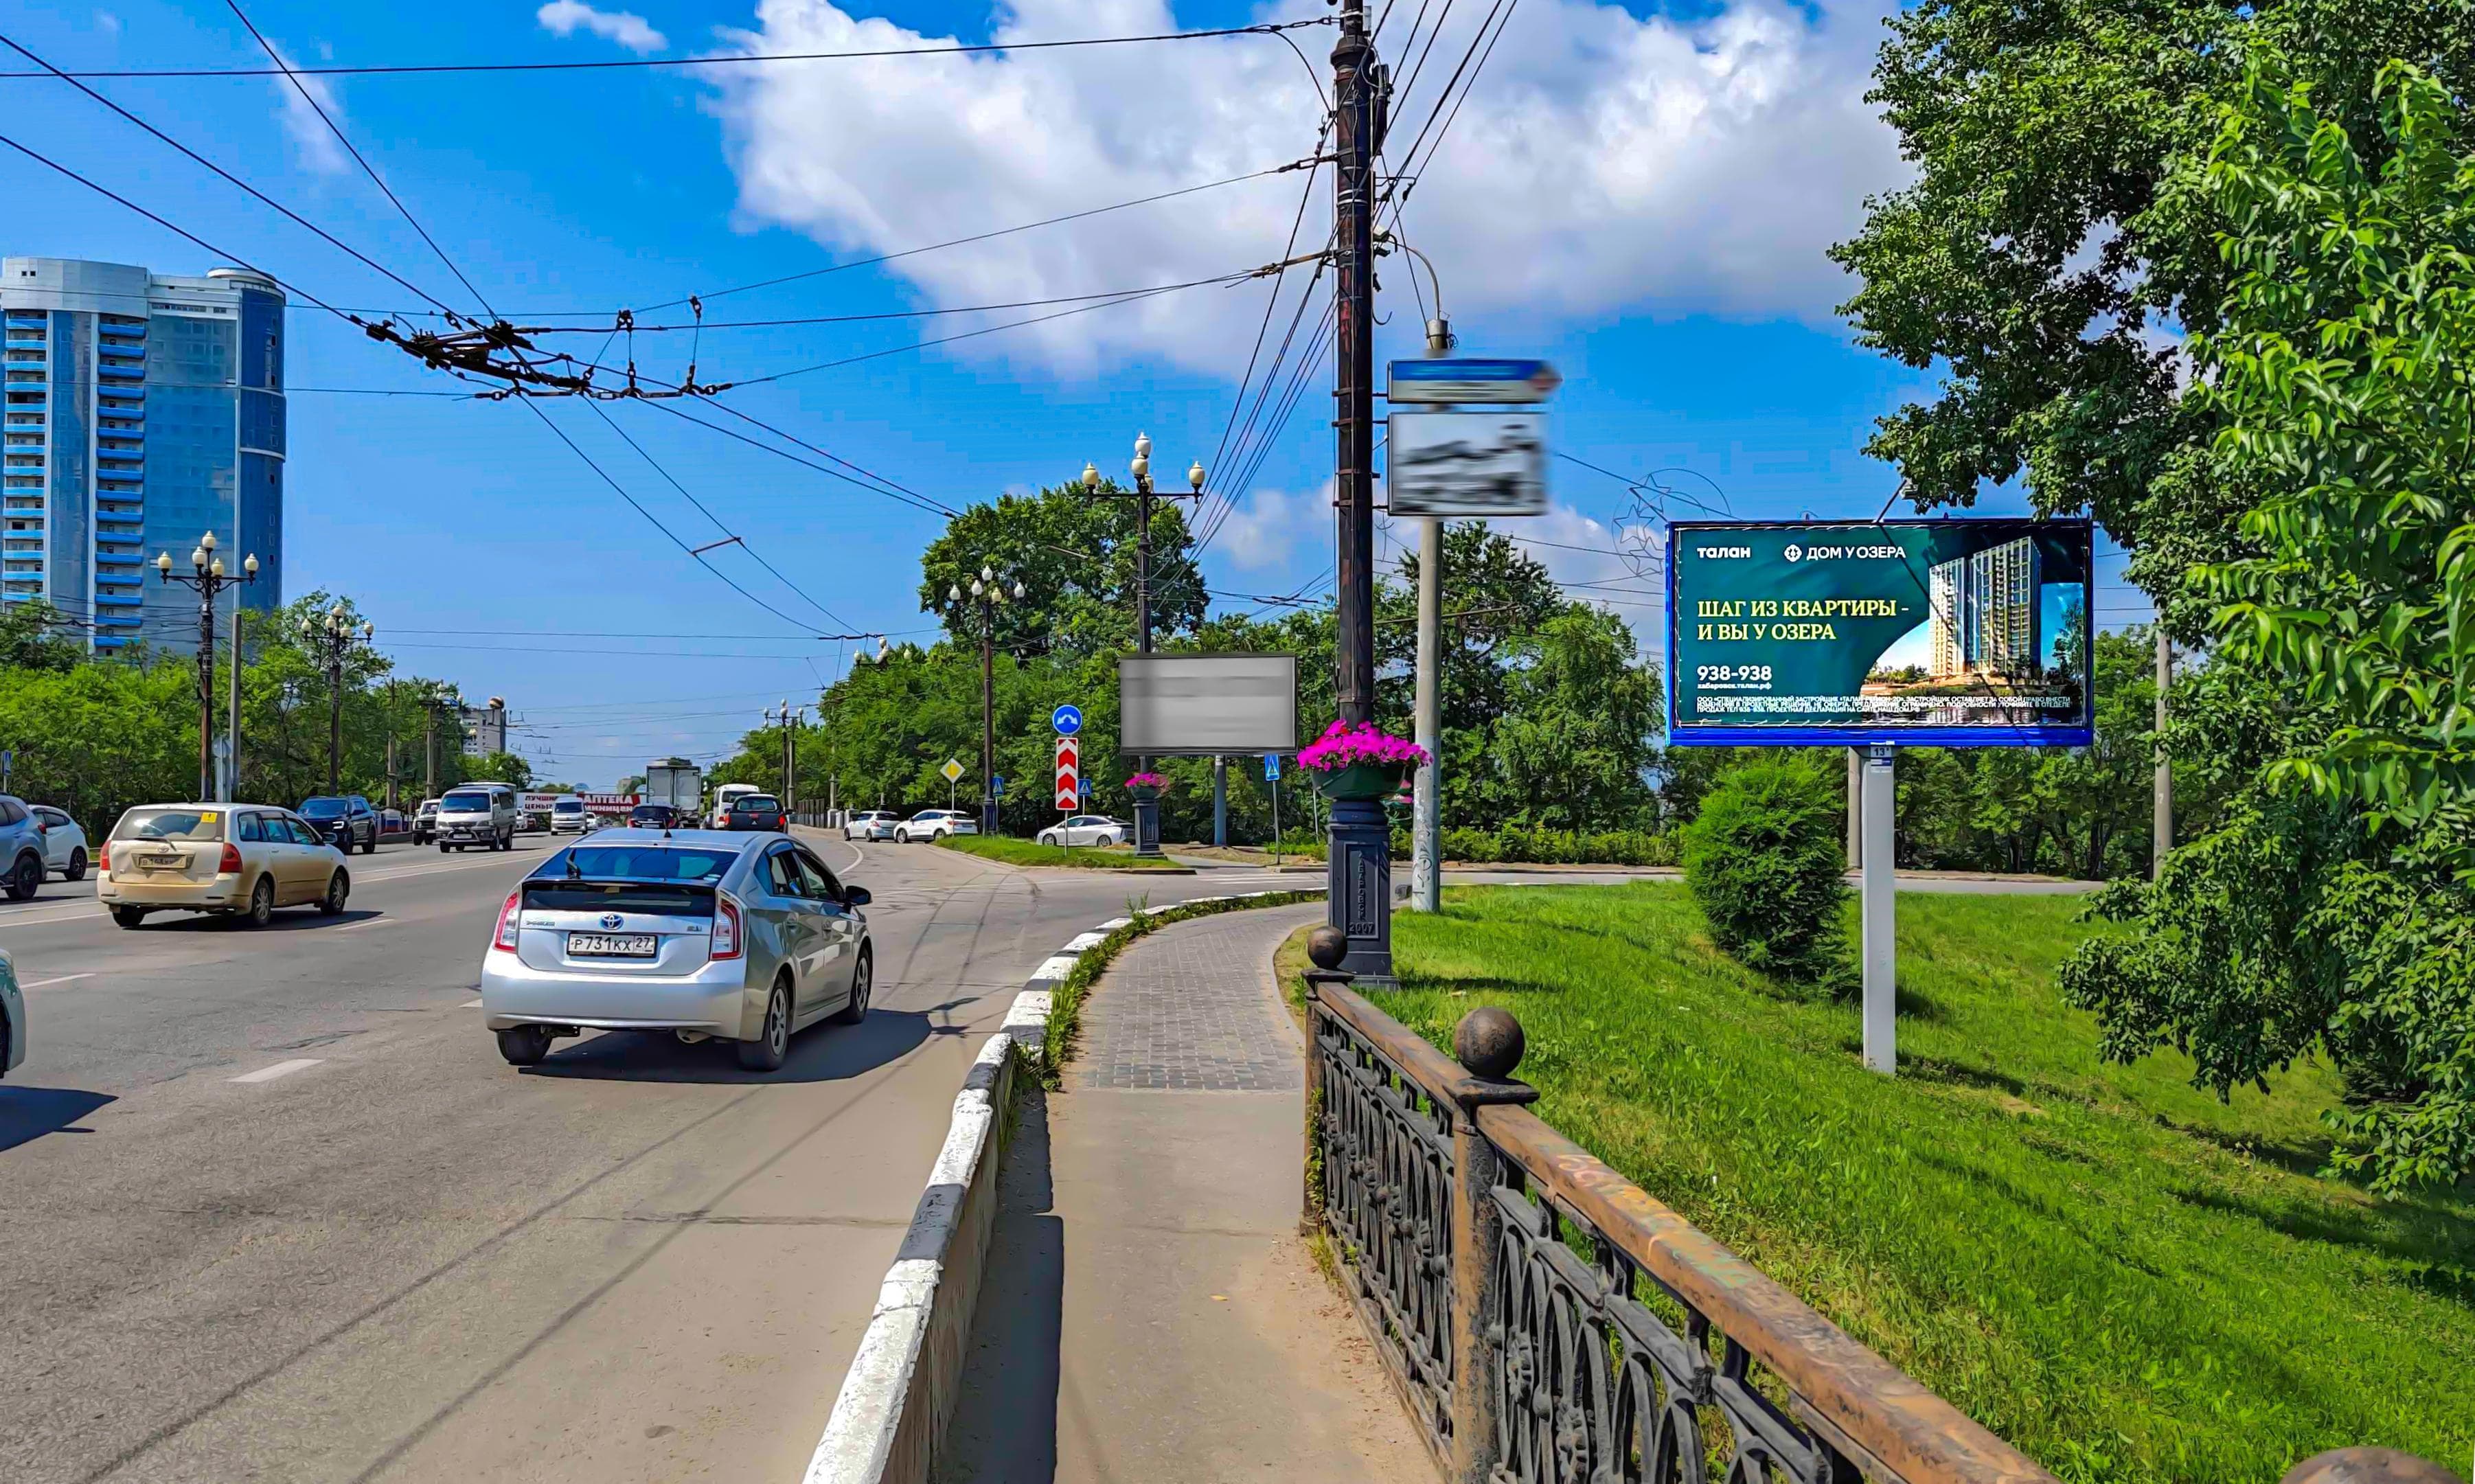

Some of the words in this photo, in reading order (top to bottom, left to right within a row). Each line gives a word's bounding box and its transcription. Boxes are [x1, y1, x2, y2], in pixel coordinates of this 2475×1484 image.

[1697, 547, 1750, 558] талан
[1806, 547, 1842, 560] ДОМ
[1845, 547, 1855, 558] У
[1856, 546, 1906, 558] ОЗЕРА
[1698, 601, 1746, 617] ШАГ
[1750, 601, 1777, 617] ИЗ
[1782, 600, 1897, 617] КВАРТИРЫ
[1698, 624, 1713, 640] И
[1718, 624, 1748, 640] ВЫ
[1753, 624, 1767, 640] У
[1772, 624, 1836, 640] ОЗЕРА
[1697, 665, 1772, 681] 938-938
[584, 795, 633, 803] АПТЕКА
